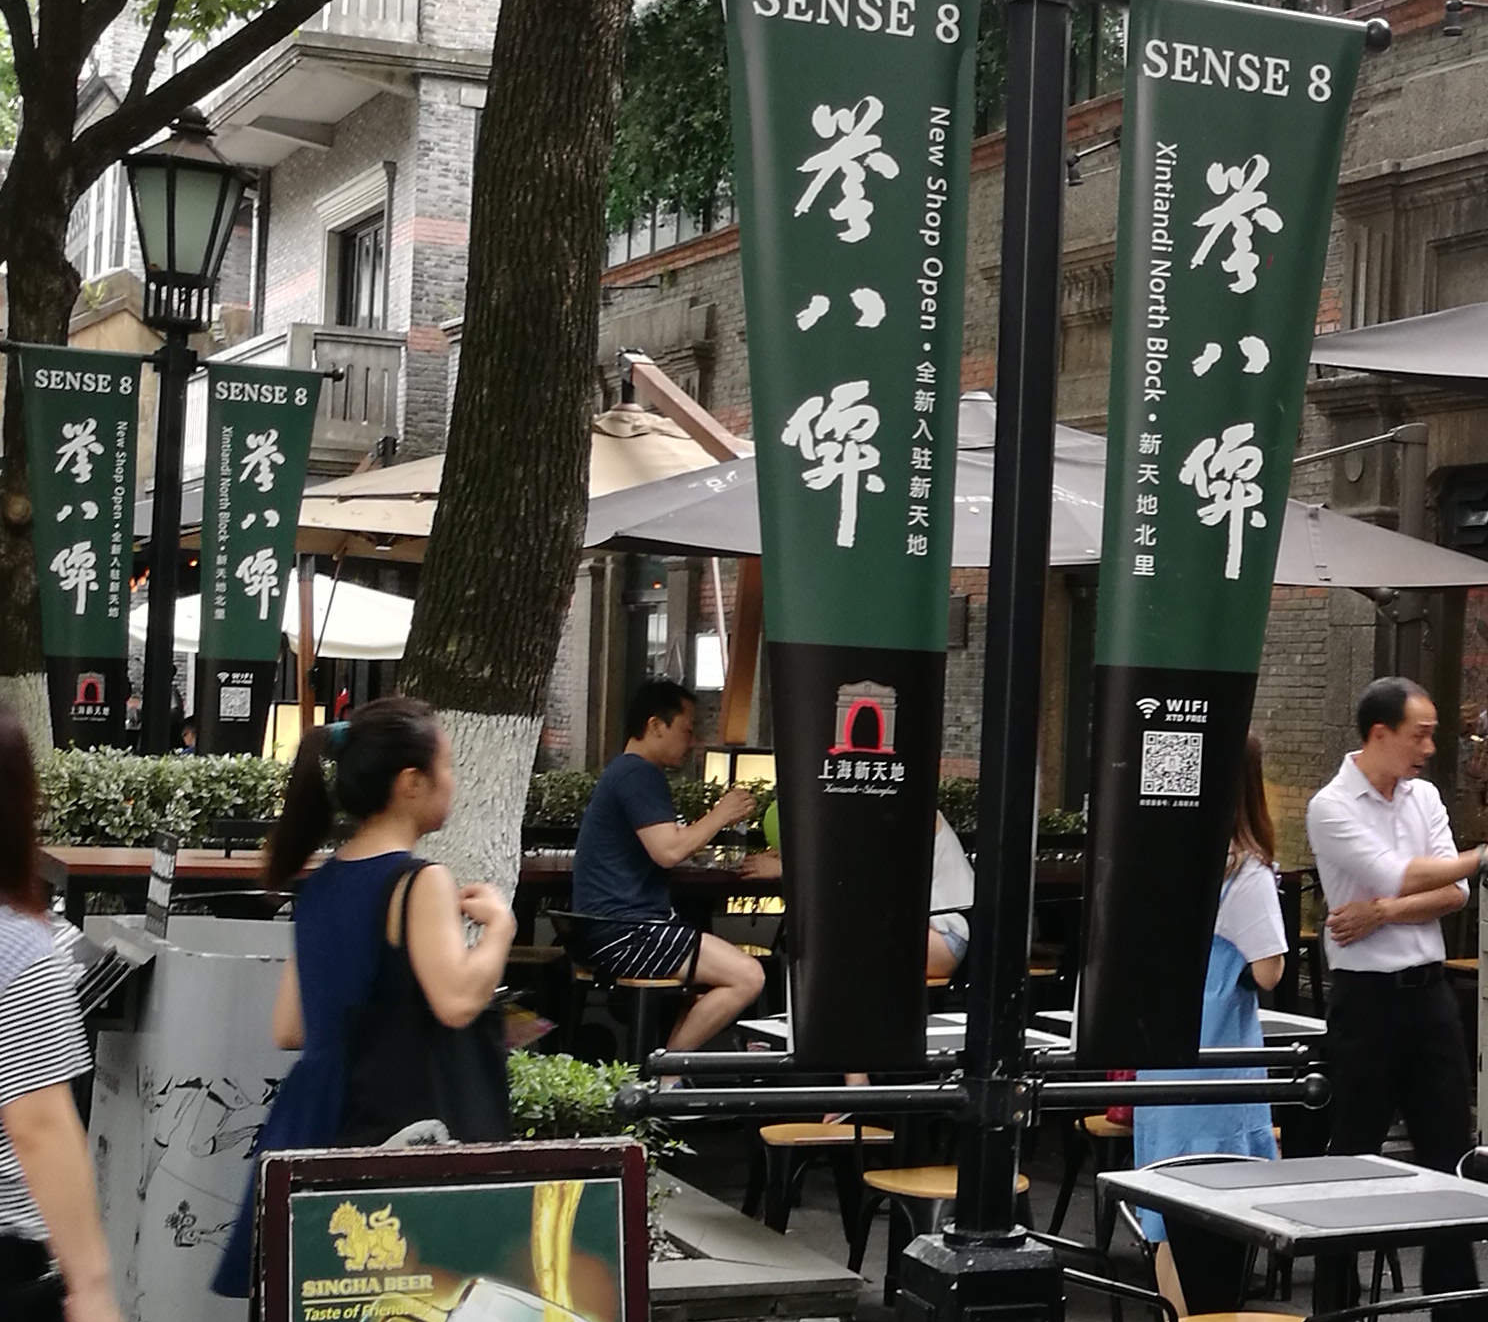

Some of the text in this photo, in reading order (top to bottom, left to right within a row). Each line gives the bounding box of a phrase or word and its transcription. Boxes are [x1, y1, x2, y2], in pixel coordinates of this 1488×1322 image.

[935, 4, 962, 43] 8
[1142, 39, 1334, 103] SENSE 8
[916, 106, 951, 331] New Shop Open
[1144, 141, 1178, 403] Xintiandi North Block
[34, 368, 133, 396] SENSE 8
[214, 381, 309, 406] SENSE 8
[112, 420, 129, 520] New Shop Open
[906, 361, 937, 556] 全新入驻新天地
[218, 477, 231, 510] North
[1132, 432, 1163, 576] 新天地北里
[1166, 699, 1208, 714] WIFI
[817, 759, 905, 782] 上海新天地
[301, 1274, 434, 1298] SINGHA BEER
[303, 1306, 341, 1322] Taste
[342, 1303, 361, 1319] of
